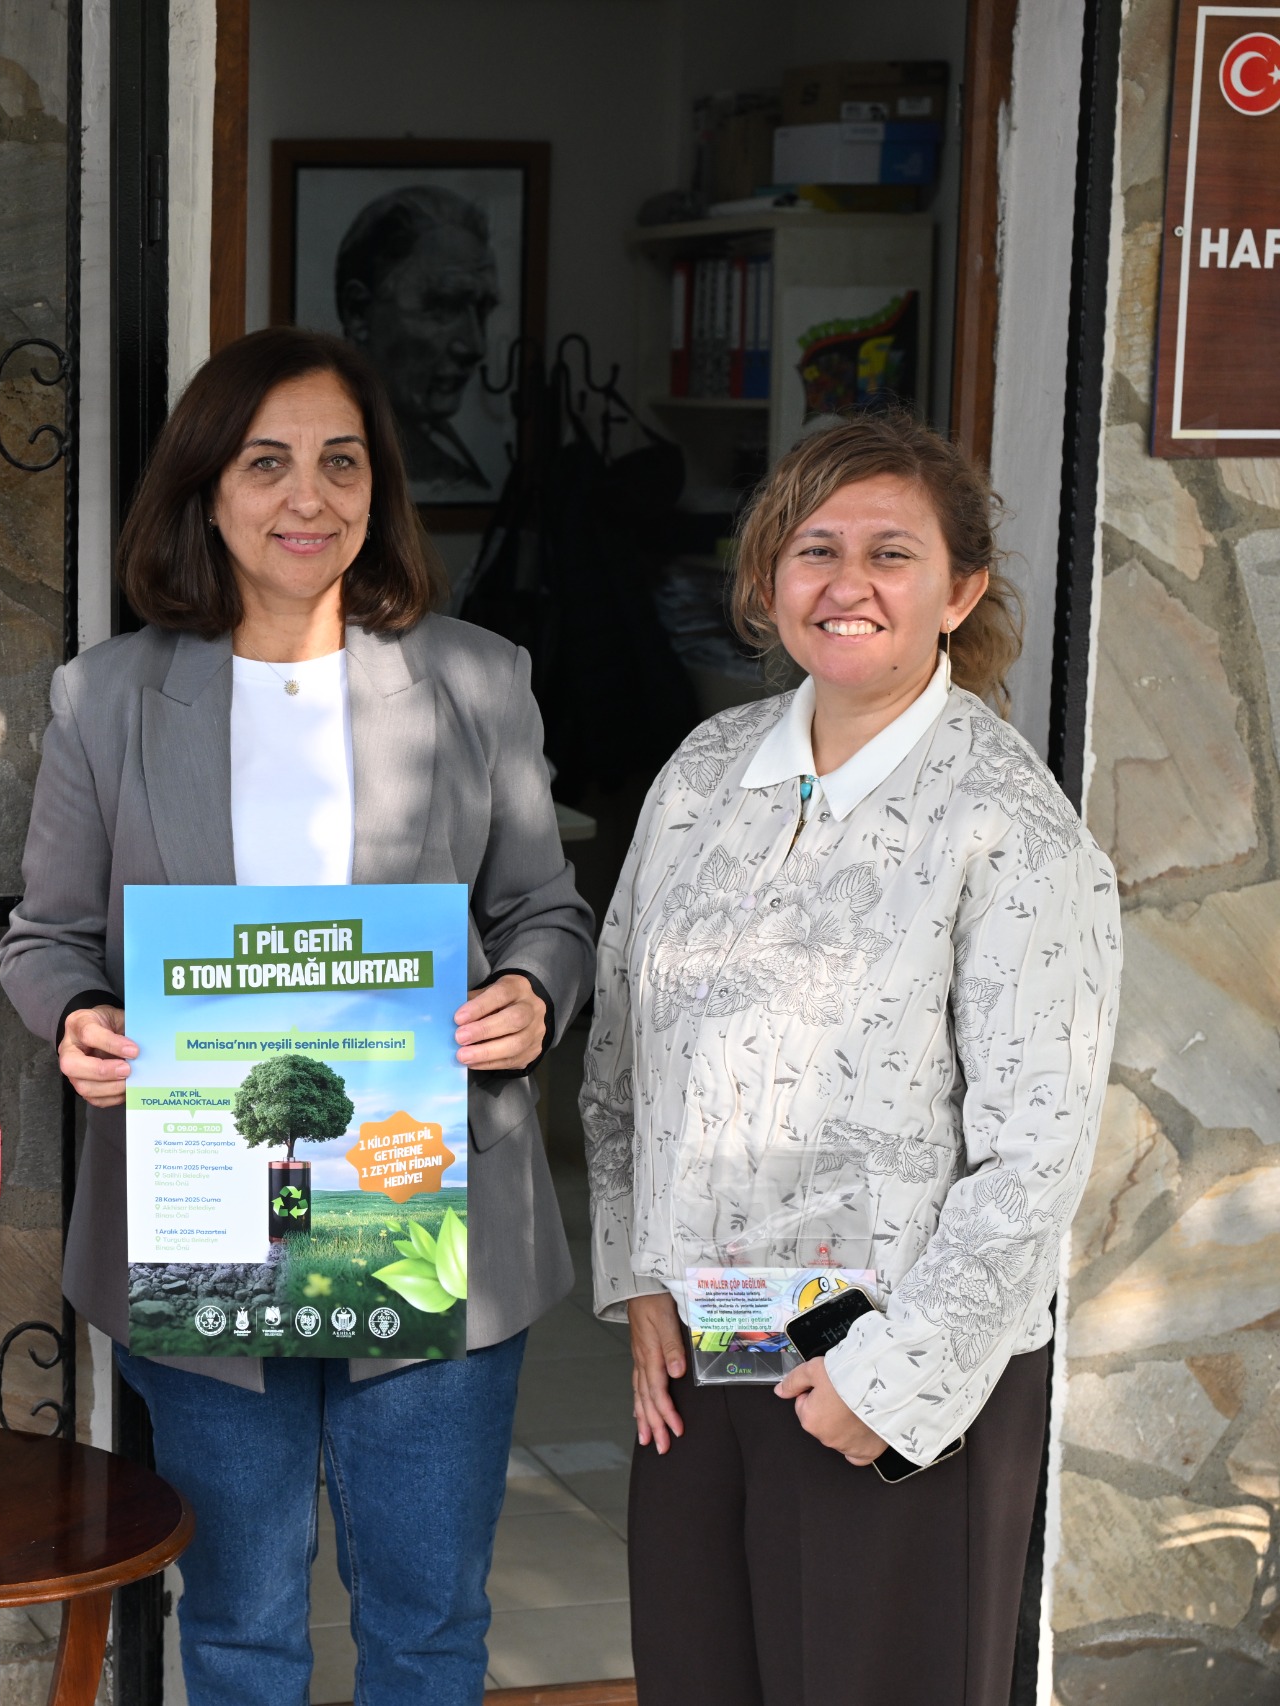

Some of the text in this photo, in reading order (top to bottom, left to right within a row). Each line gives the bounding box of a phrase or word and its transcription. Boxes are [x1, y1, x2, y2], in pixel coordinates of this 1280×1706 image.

[239, 924, 353, 954] 1 PİL GETİR
[172, 958, 419, 989] 8 TON TOPRAĞI KURTAR!
[260, 1039, 292, 1051] yeşili
[294, 1039, 339, 1050] seninle
[342, 1038, 406, 1050] filizlensin!
[190, 1089, 201, 1097] PİL
[368, 1136, 390, 1149] KİLO
[392, 1132, 415, 1145] ATIK
[418, 1127, 433, 1141] PİL
[374, 1145, 423, 1162] GETİRENE
[362, 1155, 442, 1178] 1 ZEYTİN FİDANI
[384, 1172, 422, 1188] HEDİYE!
[698, 1280, 709, 1288] ATIK
[711, 1278, 728, 1288] PİLLER
[730, 1278, 740, 1290] ÇÖP
